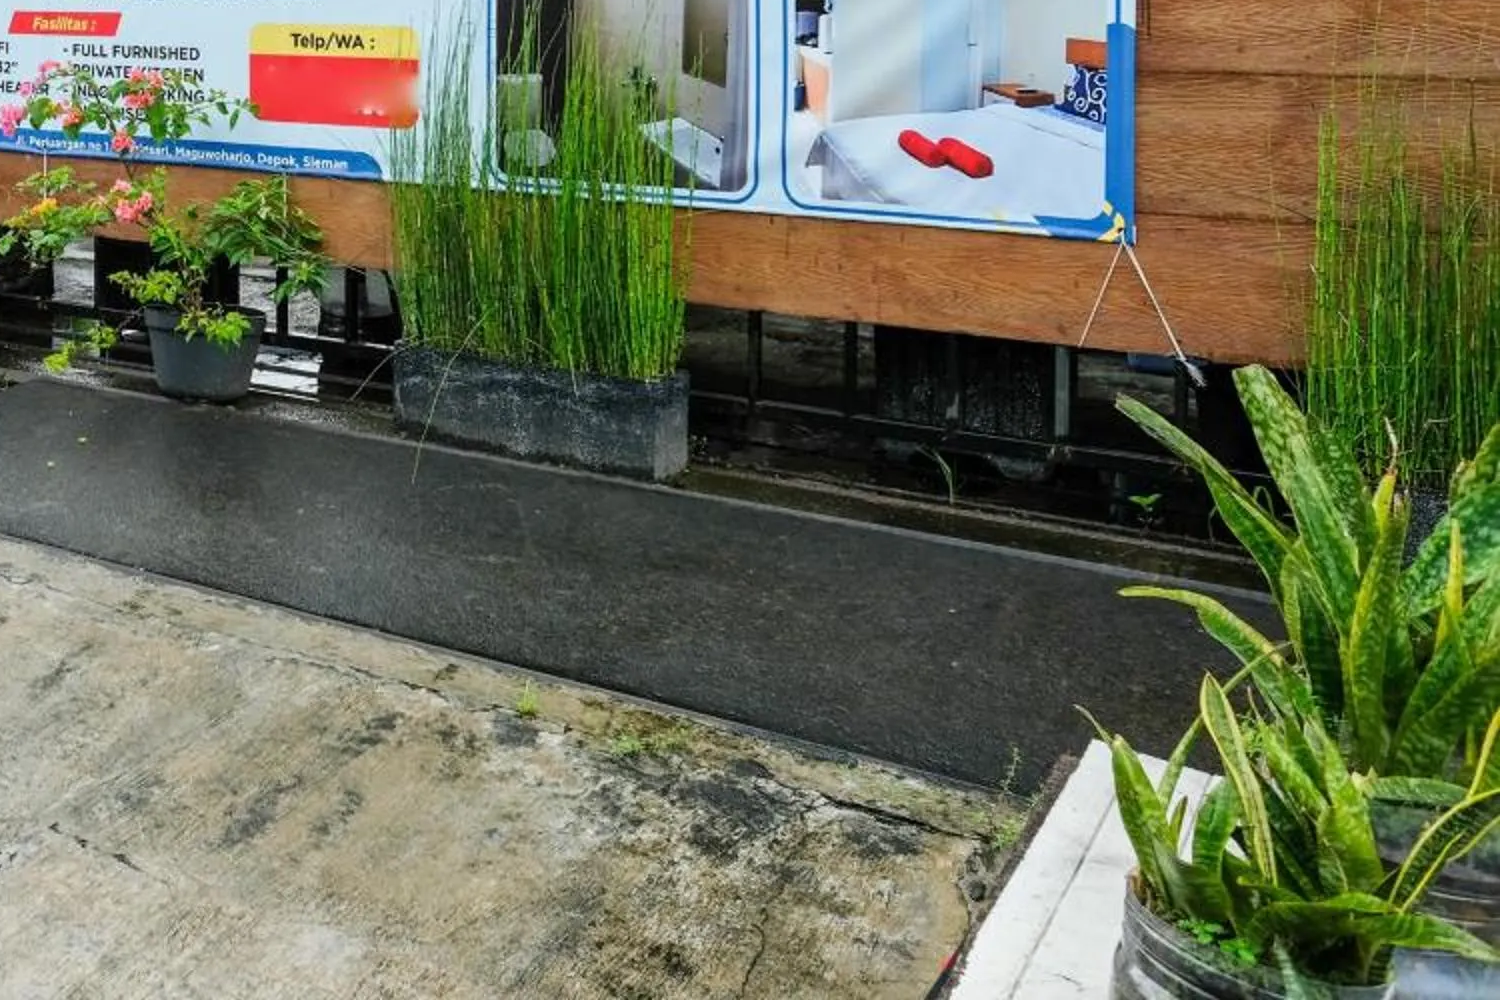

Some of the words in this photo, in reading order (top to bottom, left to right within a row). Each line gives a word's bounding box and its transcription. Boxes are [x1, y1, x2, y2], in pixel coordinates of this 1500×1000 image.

[290, 32, 365, 51] Telp/WA
[72, 43, 108, 58] FULL
[112, 45, 201, 61] FURNISHED
[257, 153, 299, 169] Depok,
[303, 156, 348, 169] Sleman
